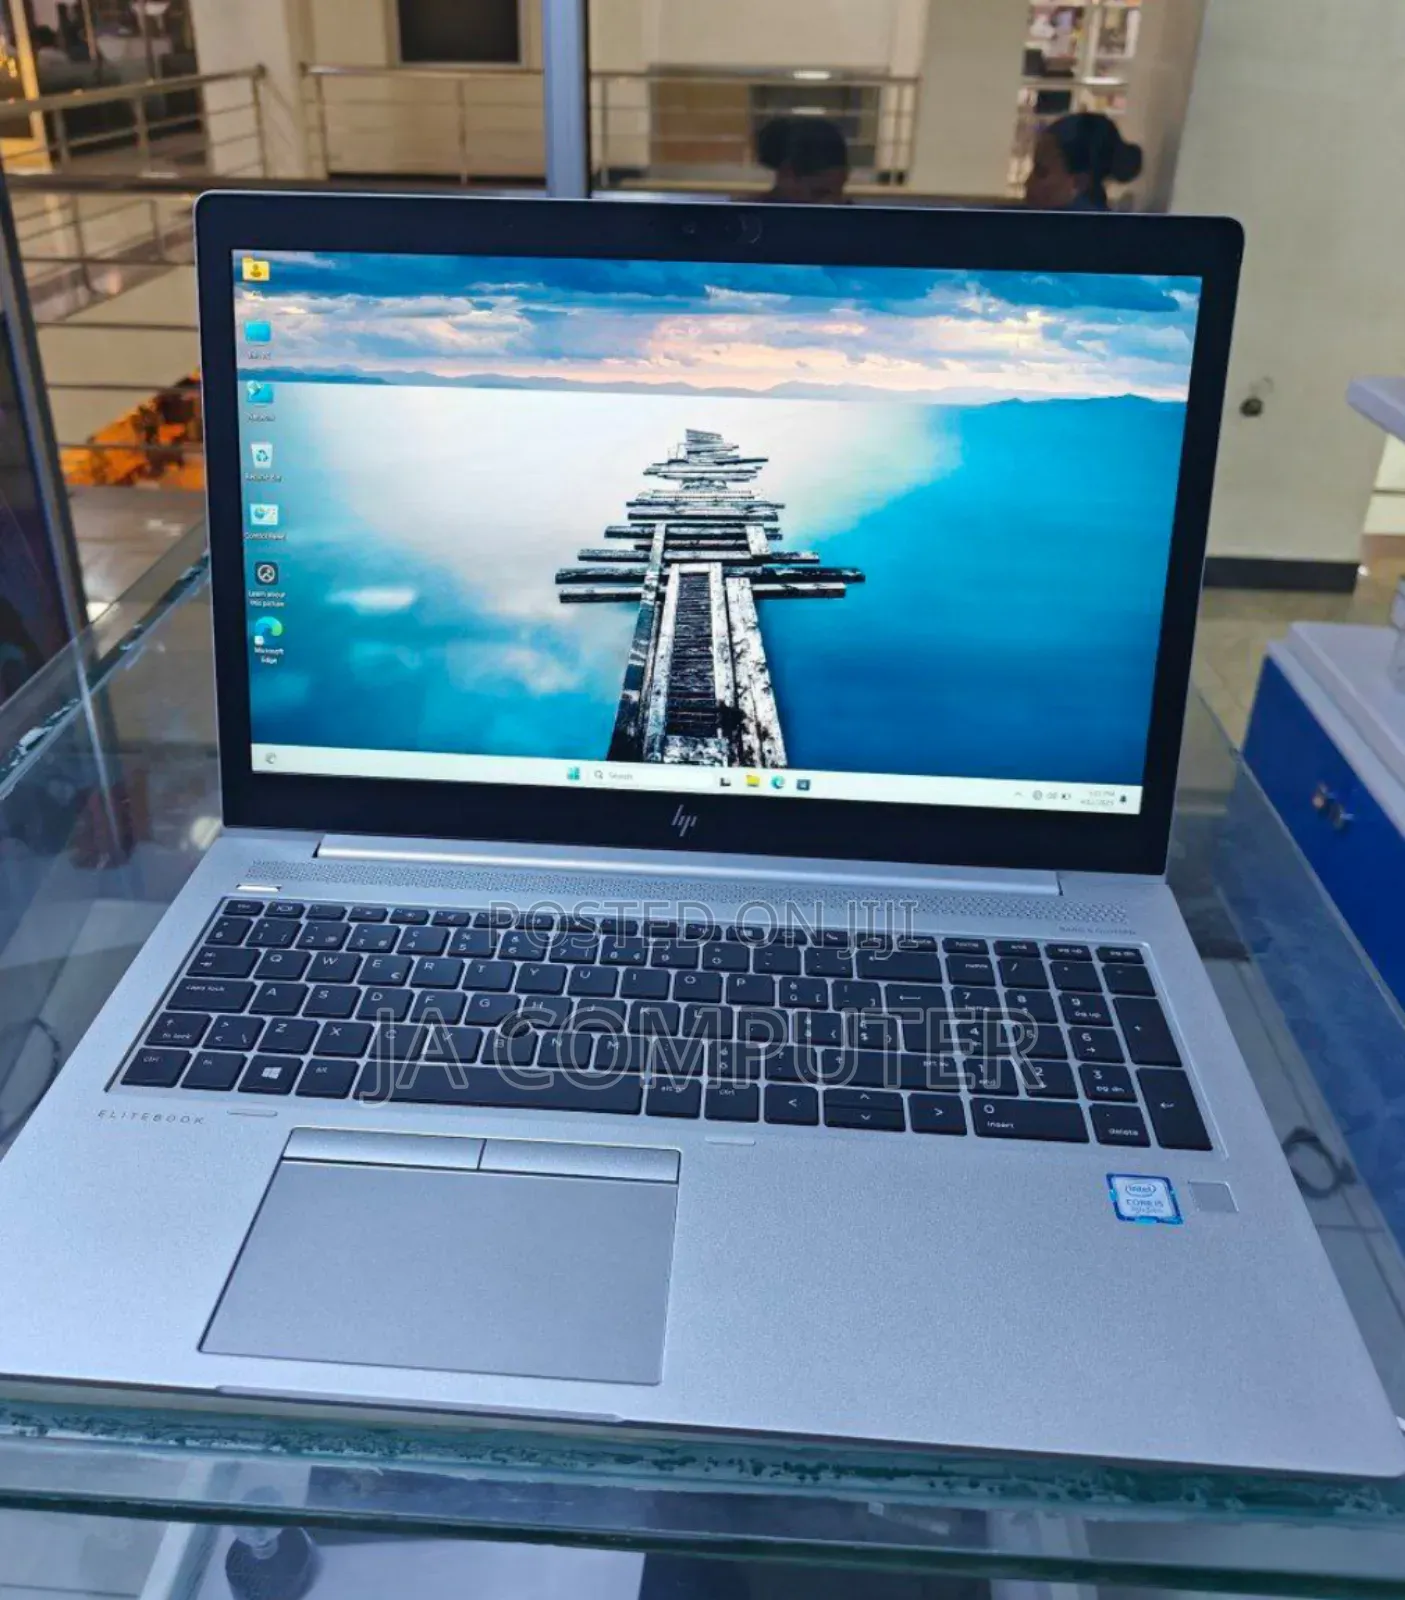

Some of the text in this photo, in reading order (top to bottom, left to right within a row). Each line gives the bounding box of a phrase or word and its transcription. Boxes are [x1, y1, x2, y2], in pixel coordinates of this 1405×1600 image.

[270, 954, 283, 963] Q
[323, 957, 338, 965] W
[372, 959, 383, 968] E
[424, 962, 434, 970] R
[478, 964, 486, 973] T
[530, 968, 540, 976] Y
[580, 970, 591, 979] U
[684, 976, 696, 984] O
[737, 977, 746, 986] P
[266, 987, 277, 996] A
[318, 990, 330, 999] S
[963, 992, 971, 1000] 7
[371, 992, 383, 1001] D
[424, 995, 434, 1004] F
[479, 999, 491, 1008] G
[1071, 998, 1081, 1006] 9
[275, 1024, 287, 1033] Z
[330, 1027, 342, 1036] X
[1081, 1032, 1091, 1042] 6
[1034, 1067, 1045, 1076] 2
[1093, 1070, 1103, 1079] 3
[98, 1110, 205, 1125] ELITEBOOK
[1108, 1128, 1139, 1136] delete
